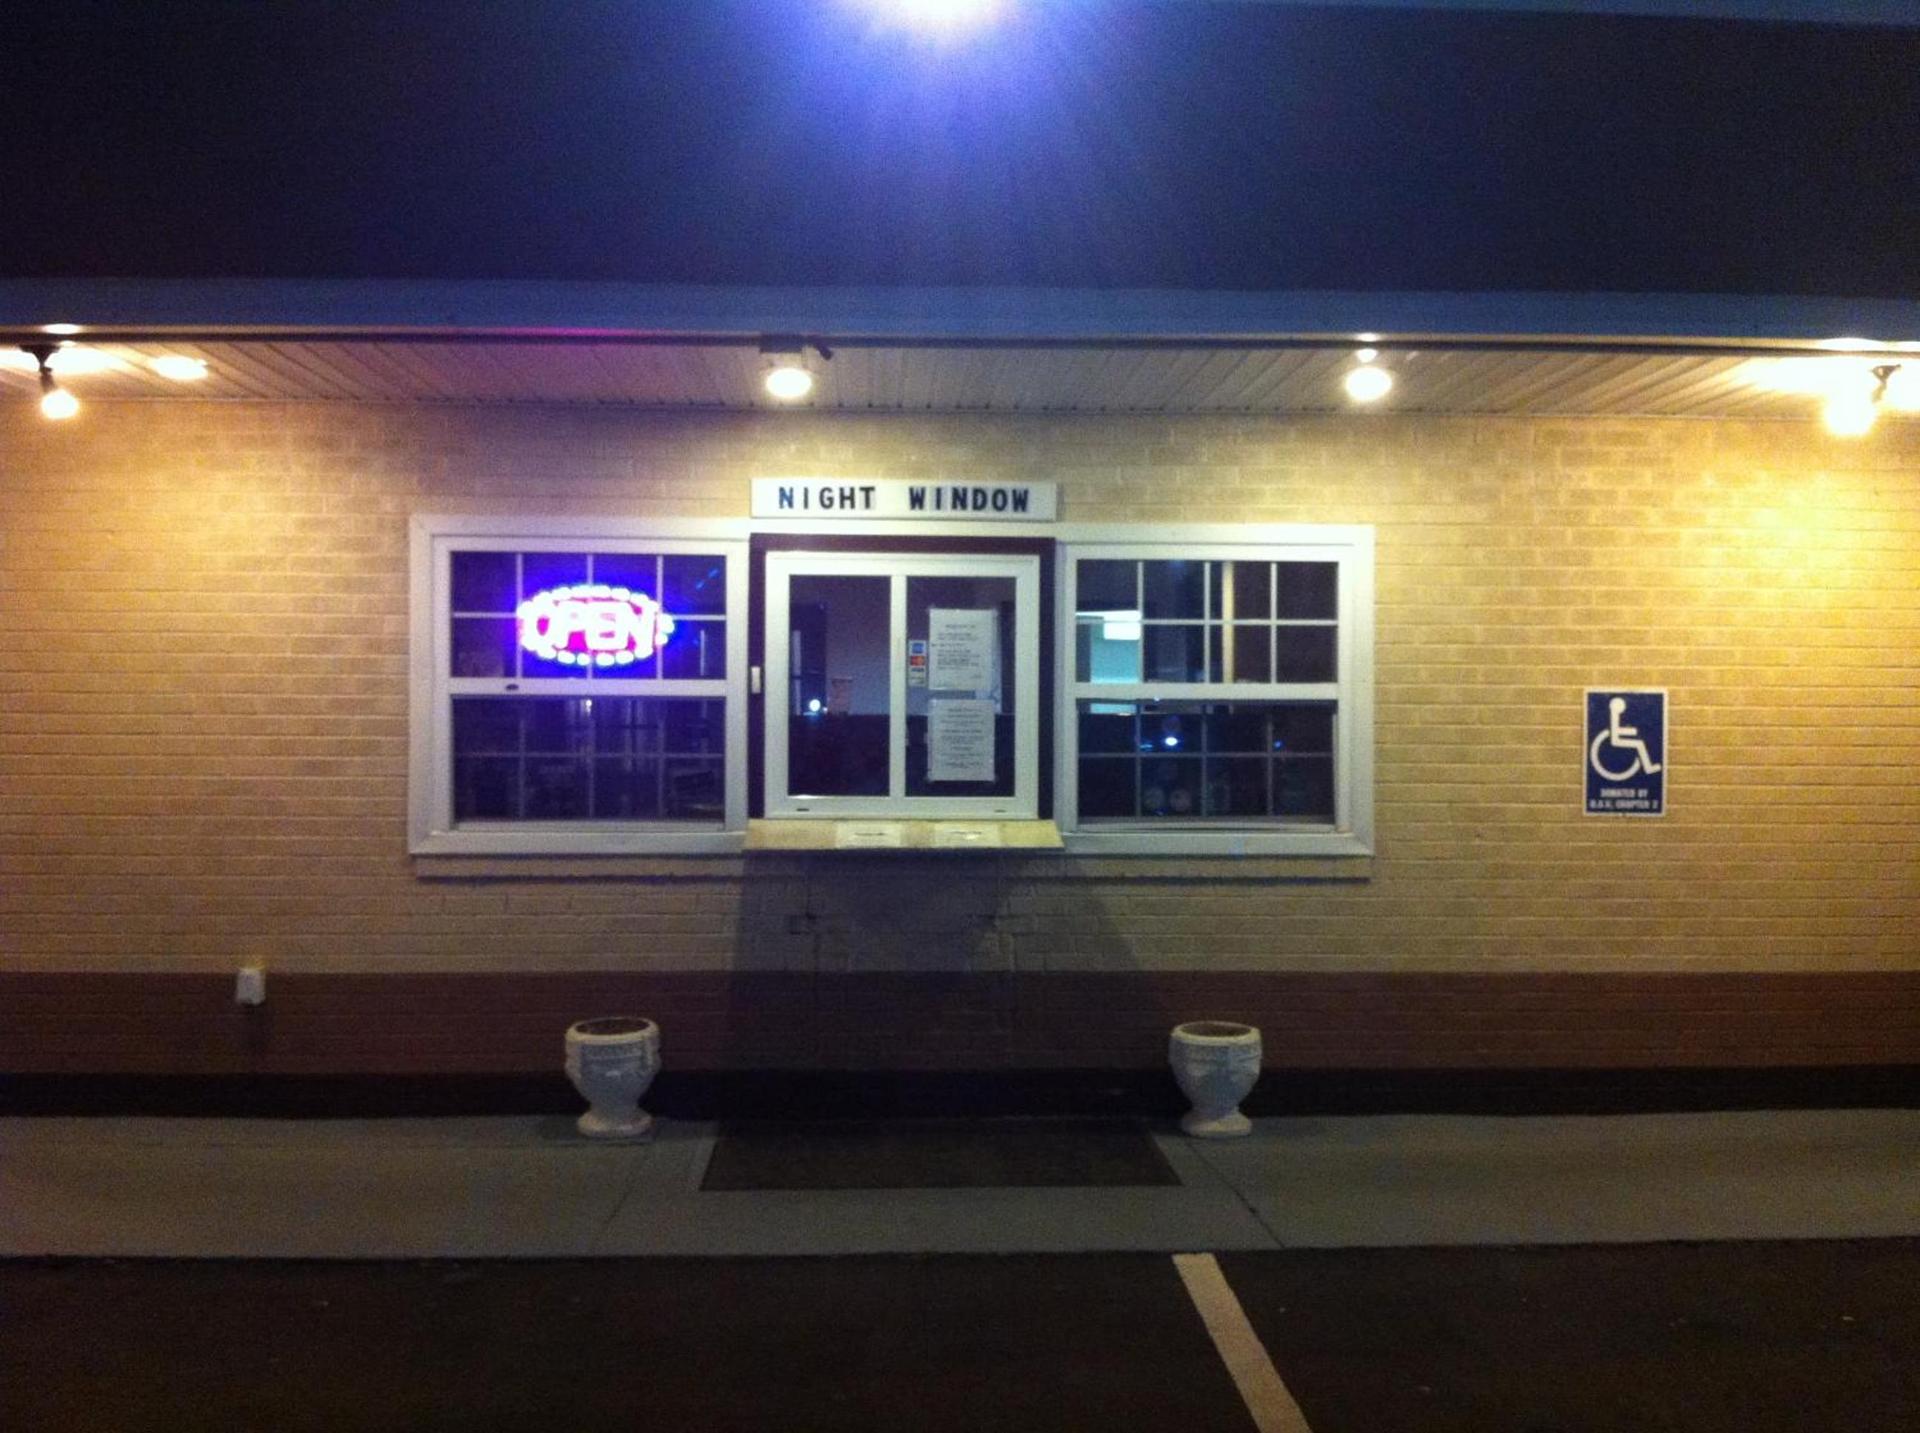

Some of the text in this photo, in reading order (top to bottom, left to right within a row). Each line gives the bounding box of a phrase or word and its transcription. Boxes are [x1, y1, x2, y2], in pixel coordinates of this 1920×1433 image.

[778, 486, 1029, 512] NIGHT WINDOW
[529, 598, 653, 650] OPEN
